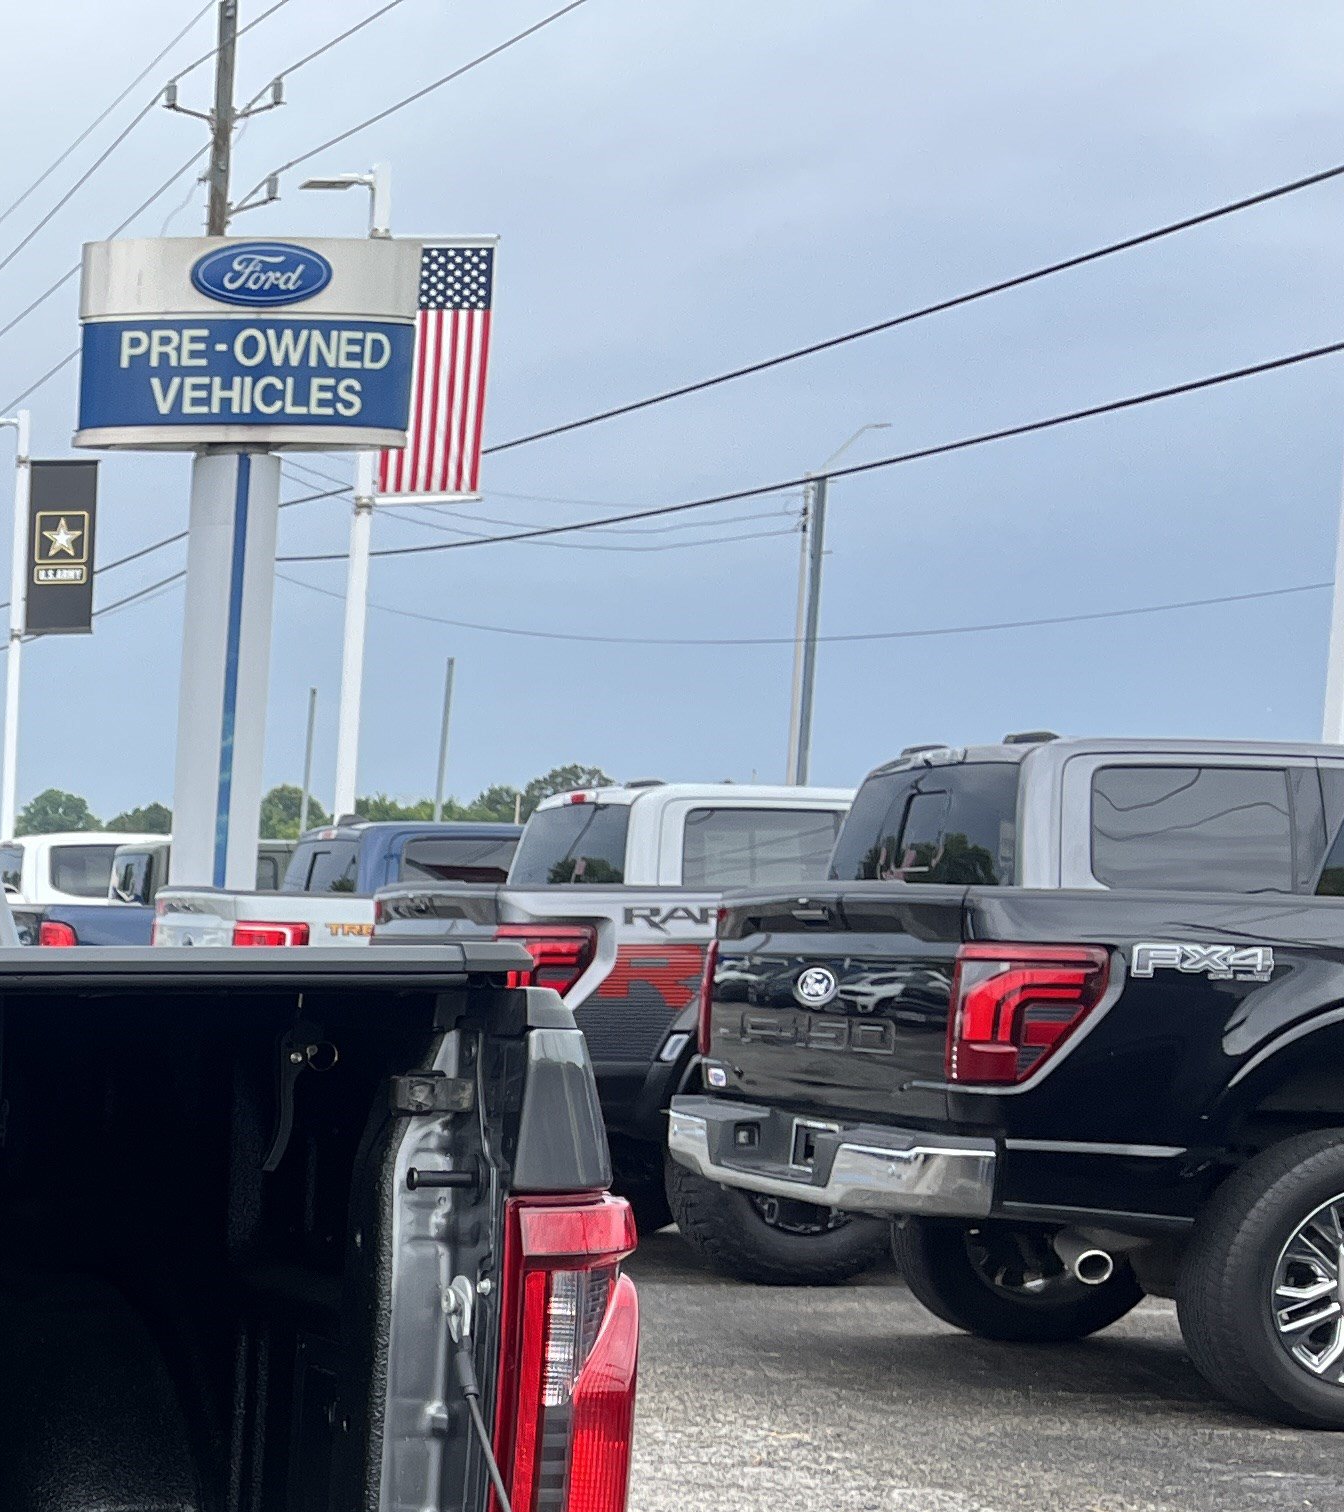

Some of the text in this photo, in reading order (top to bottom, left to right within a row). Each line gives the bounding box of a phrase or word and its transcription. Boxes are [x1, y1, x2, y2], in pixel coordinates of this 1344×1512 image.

[223, 253, 306, 291] Ford
[120, 328, 392, 370] PRE-OWNED
[150, 376, 362, 417] VEHICLES
[1131, 943, 1275, 978] FX4
